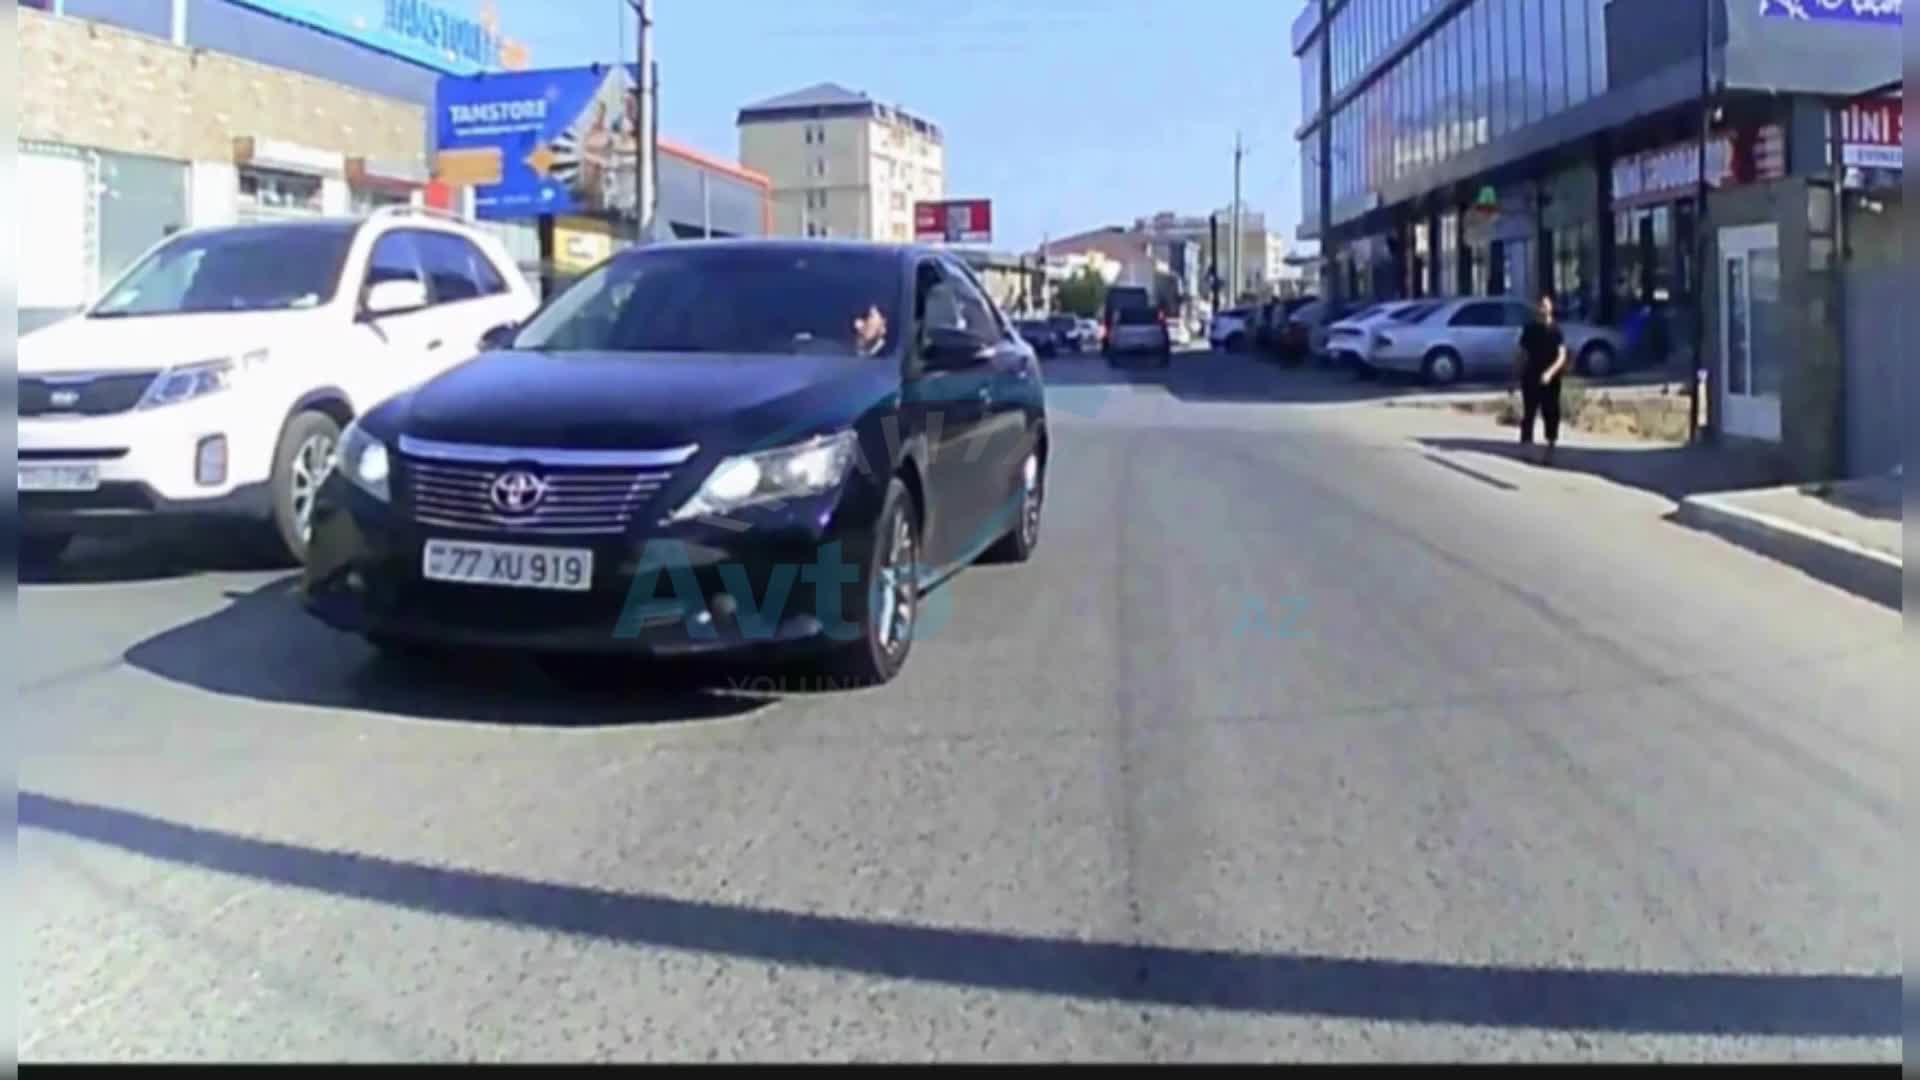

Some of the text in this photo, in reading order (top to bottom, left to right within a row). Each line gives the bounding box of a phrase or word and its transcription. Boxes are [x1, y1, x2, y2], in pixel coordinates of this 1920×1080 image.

[448, 98, 548, 124] TAMSTORE
[449, 546, 582, 586] 77 XU 919
